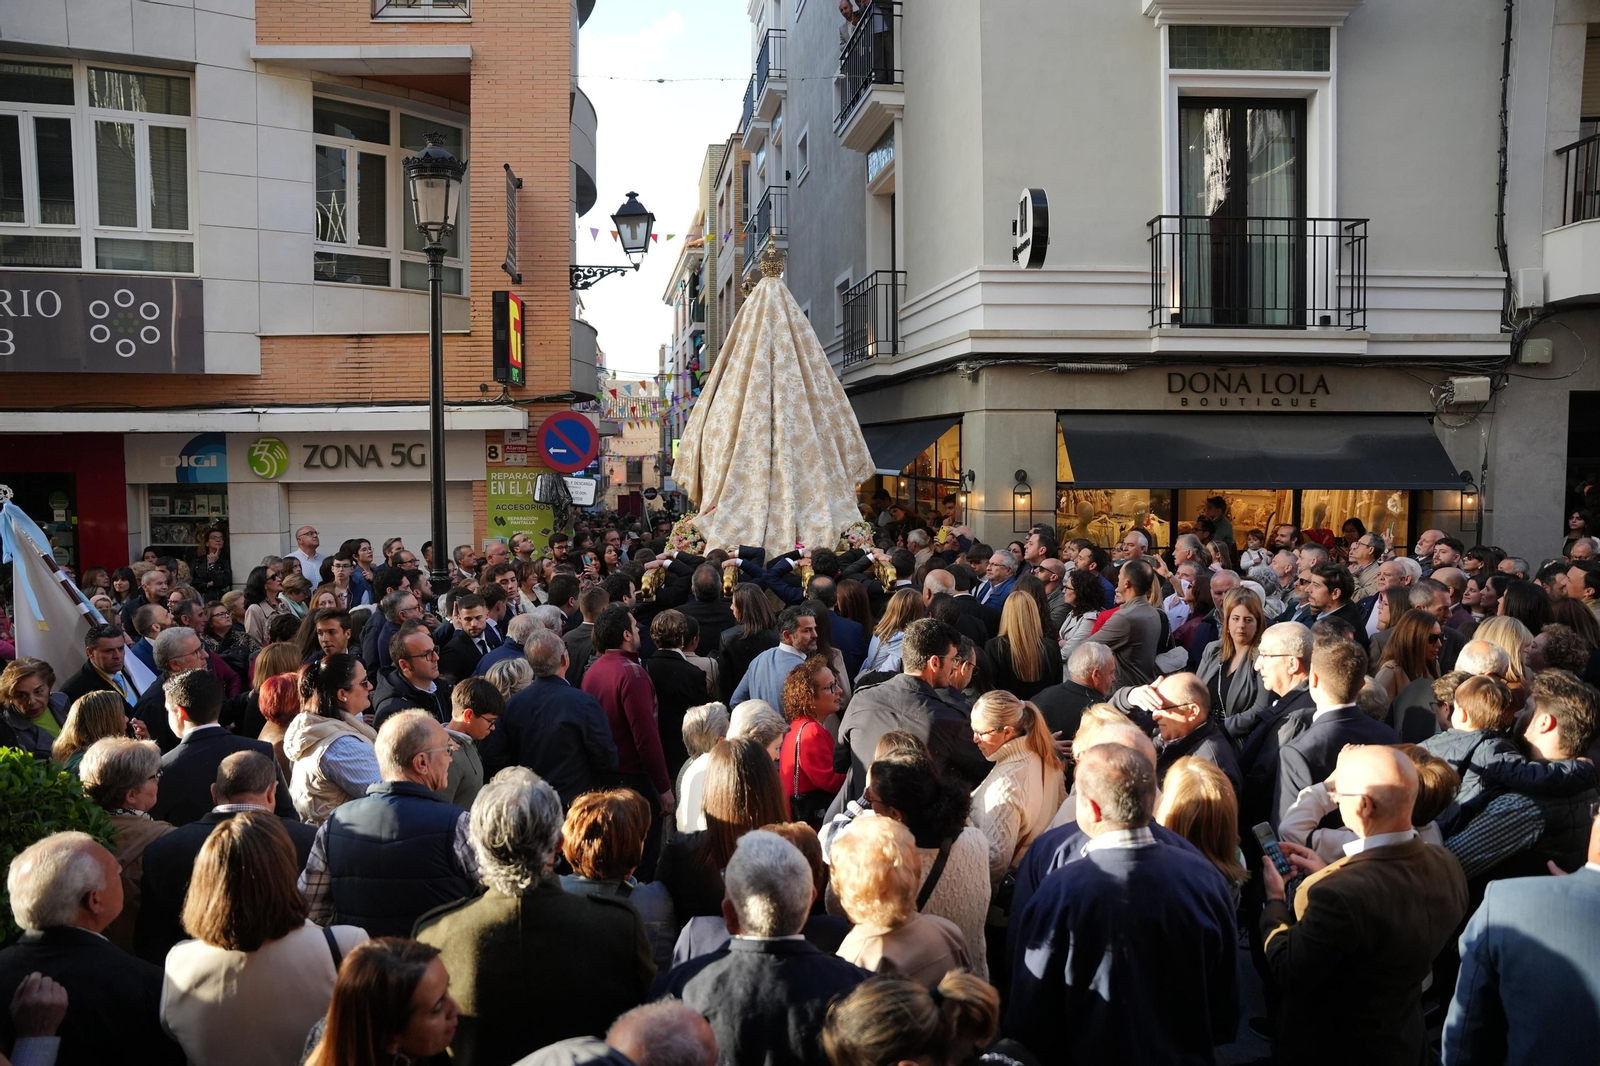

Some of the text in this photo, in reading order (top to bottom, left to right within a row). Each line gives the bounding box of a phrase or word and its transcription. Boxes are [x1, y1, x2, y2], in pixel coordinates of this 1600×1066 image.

[1167, 368, 1331, 395] DOÑA LOLA
[1181, 397, 1318, 408] BOUTIQUE
[303, 444, 383, 469] ZONA
[390, 442, 427, 468] 5G
[487, 445, 499, 460] 8
[160, 454, 218, 468] DIGI
[491, 481, 505, 495] EN
[510, 481, 523, 495] EL
